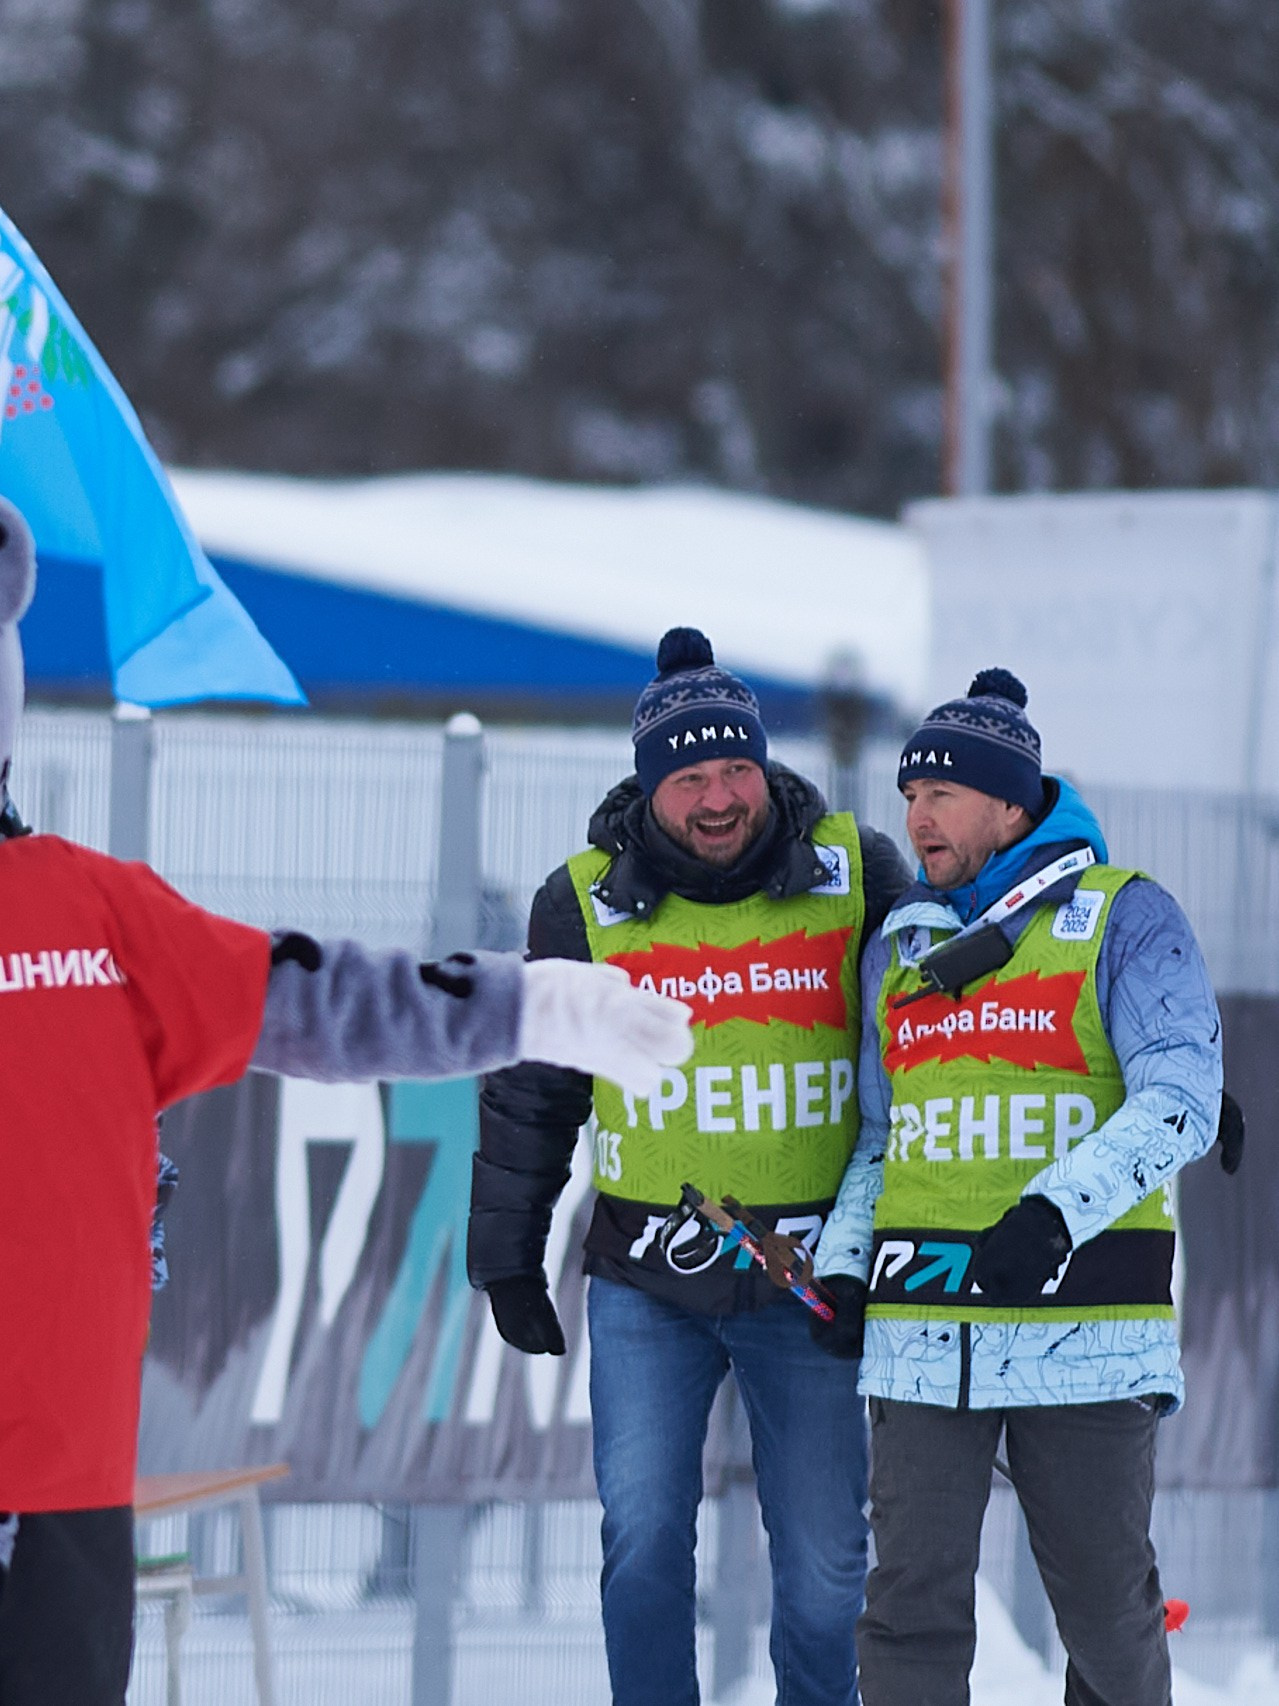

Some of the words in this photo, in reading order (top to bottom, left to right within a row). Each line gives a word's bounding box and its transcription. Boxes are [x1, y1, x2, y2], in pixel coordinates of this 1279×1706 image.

[667, 725, 749, 750] YAMAL
[900, 749, 953, 768] AMAL
[1060, 919, 1088, 933] 2025
[636, 966, 744, 1003] Альфа
[749, 962, 829, 992] Банк
[980, 1000, 1057, 1033] Банк
